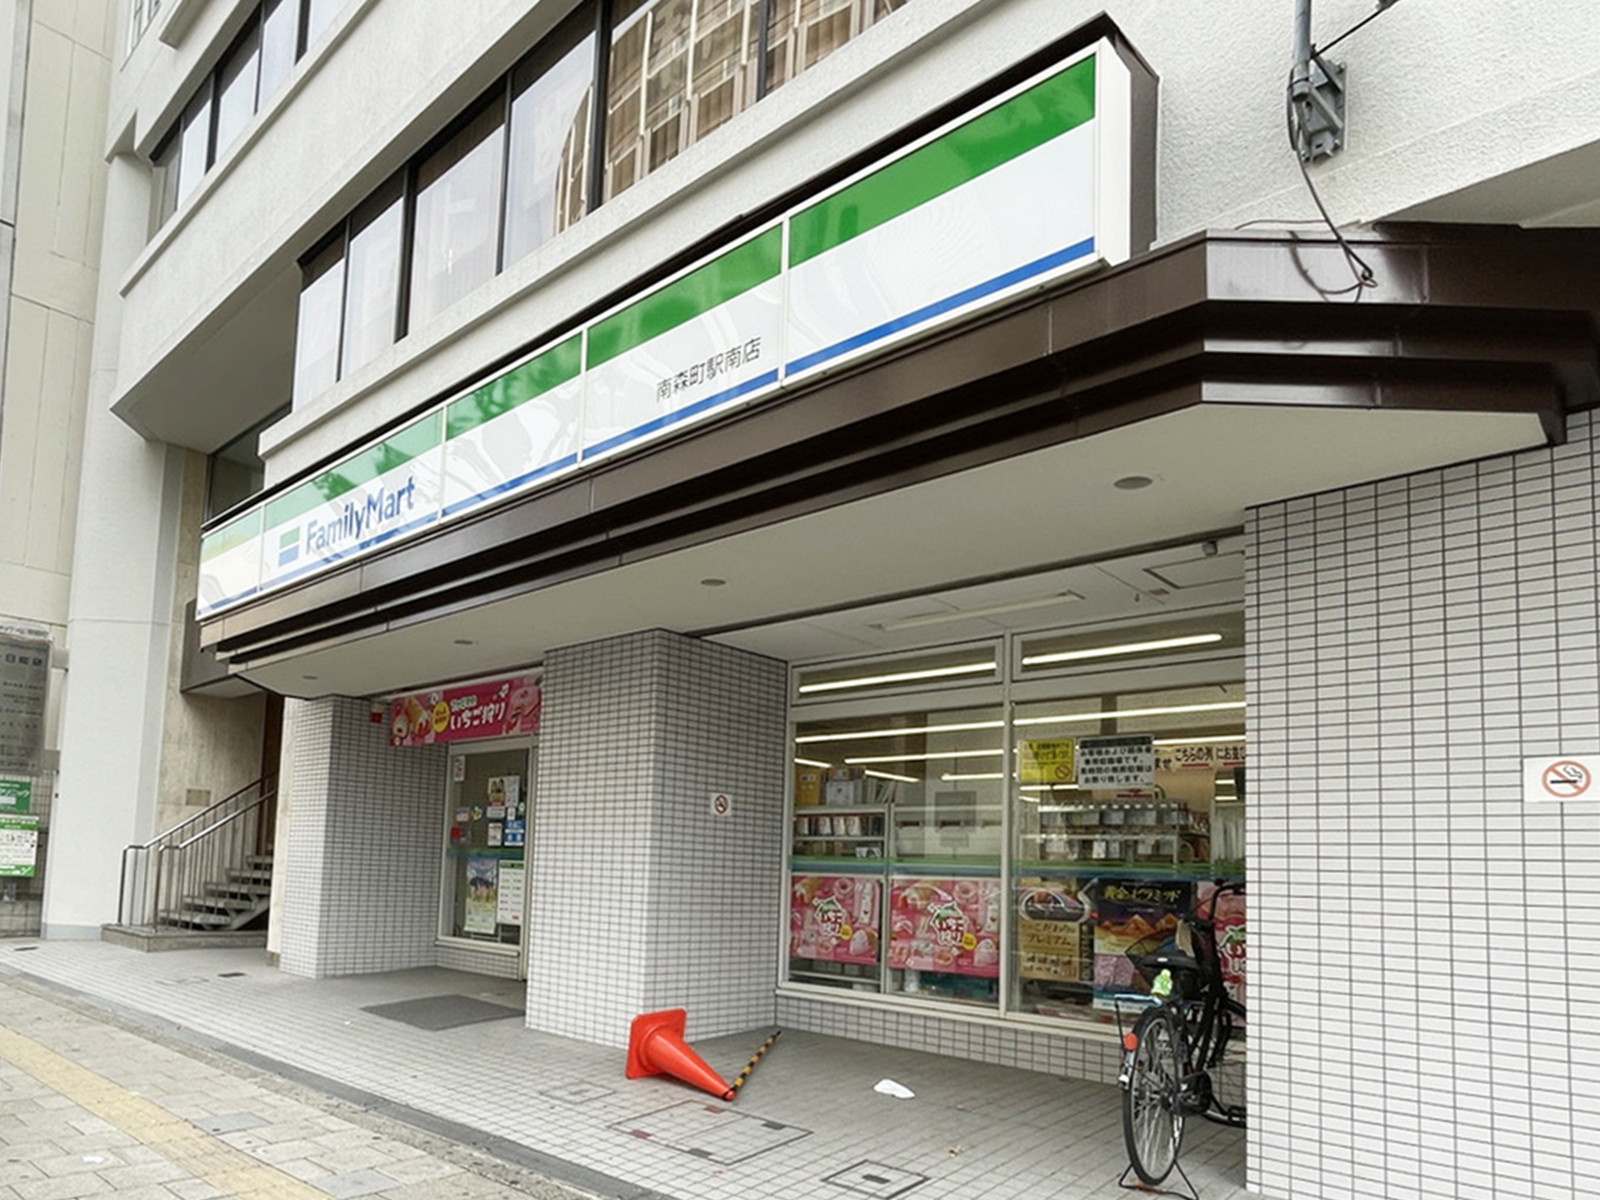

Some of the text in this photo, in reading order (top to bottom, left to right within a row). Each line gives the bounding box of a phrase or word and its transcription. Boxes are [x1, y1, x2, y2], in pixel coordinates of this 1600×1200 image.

[656, 336, 761, 403] 南森町駅南店
[305, 476, 415, 555] FamilyMart
[450, 701, 505, 731] いちご狩り
